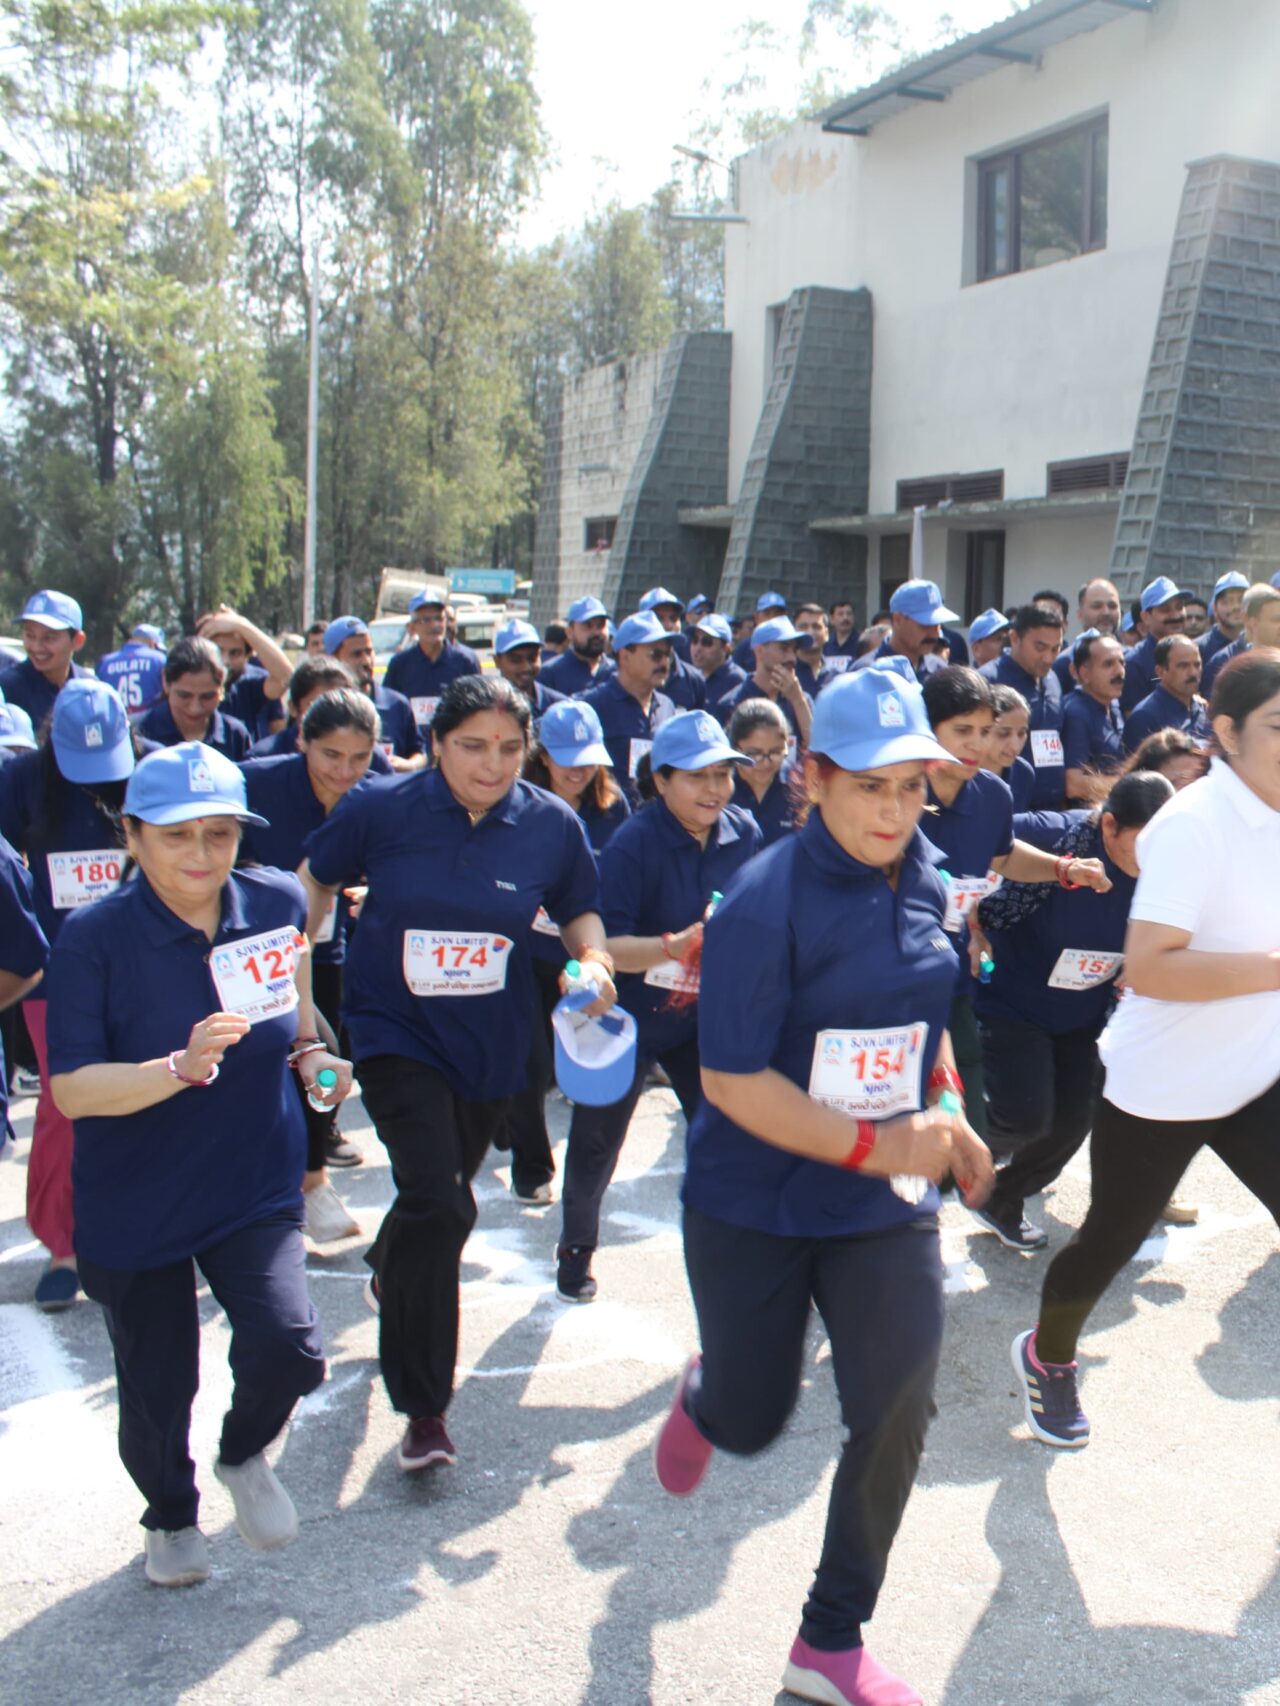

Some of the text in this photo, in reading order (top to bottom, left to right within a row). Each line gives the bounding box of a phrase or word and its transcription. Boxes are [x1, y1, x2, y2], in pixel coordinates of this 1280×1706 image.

[118, 673, 143, 706] 45
[72, 861, 120, 883] 180
[432, 945, 488, 968] 174
[849, 1046, 905, 1080] 154
